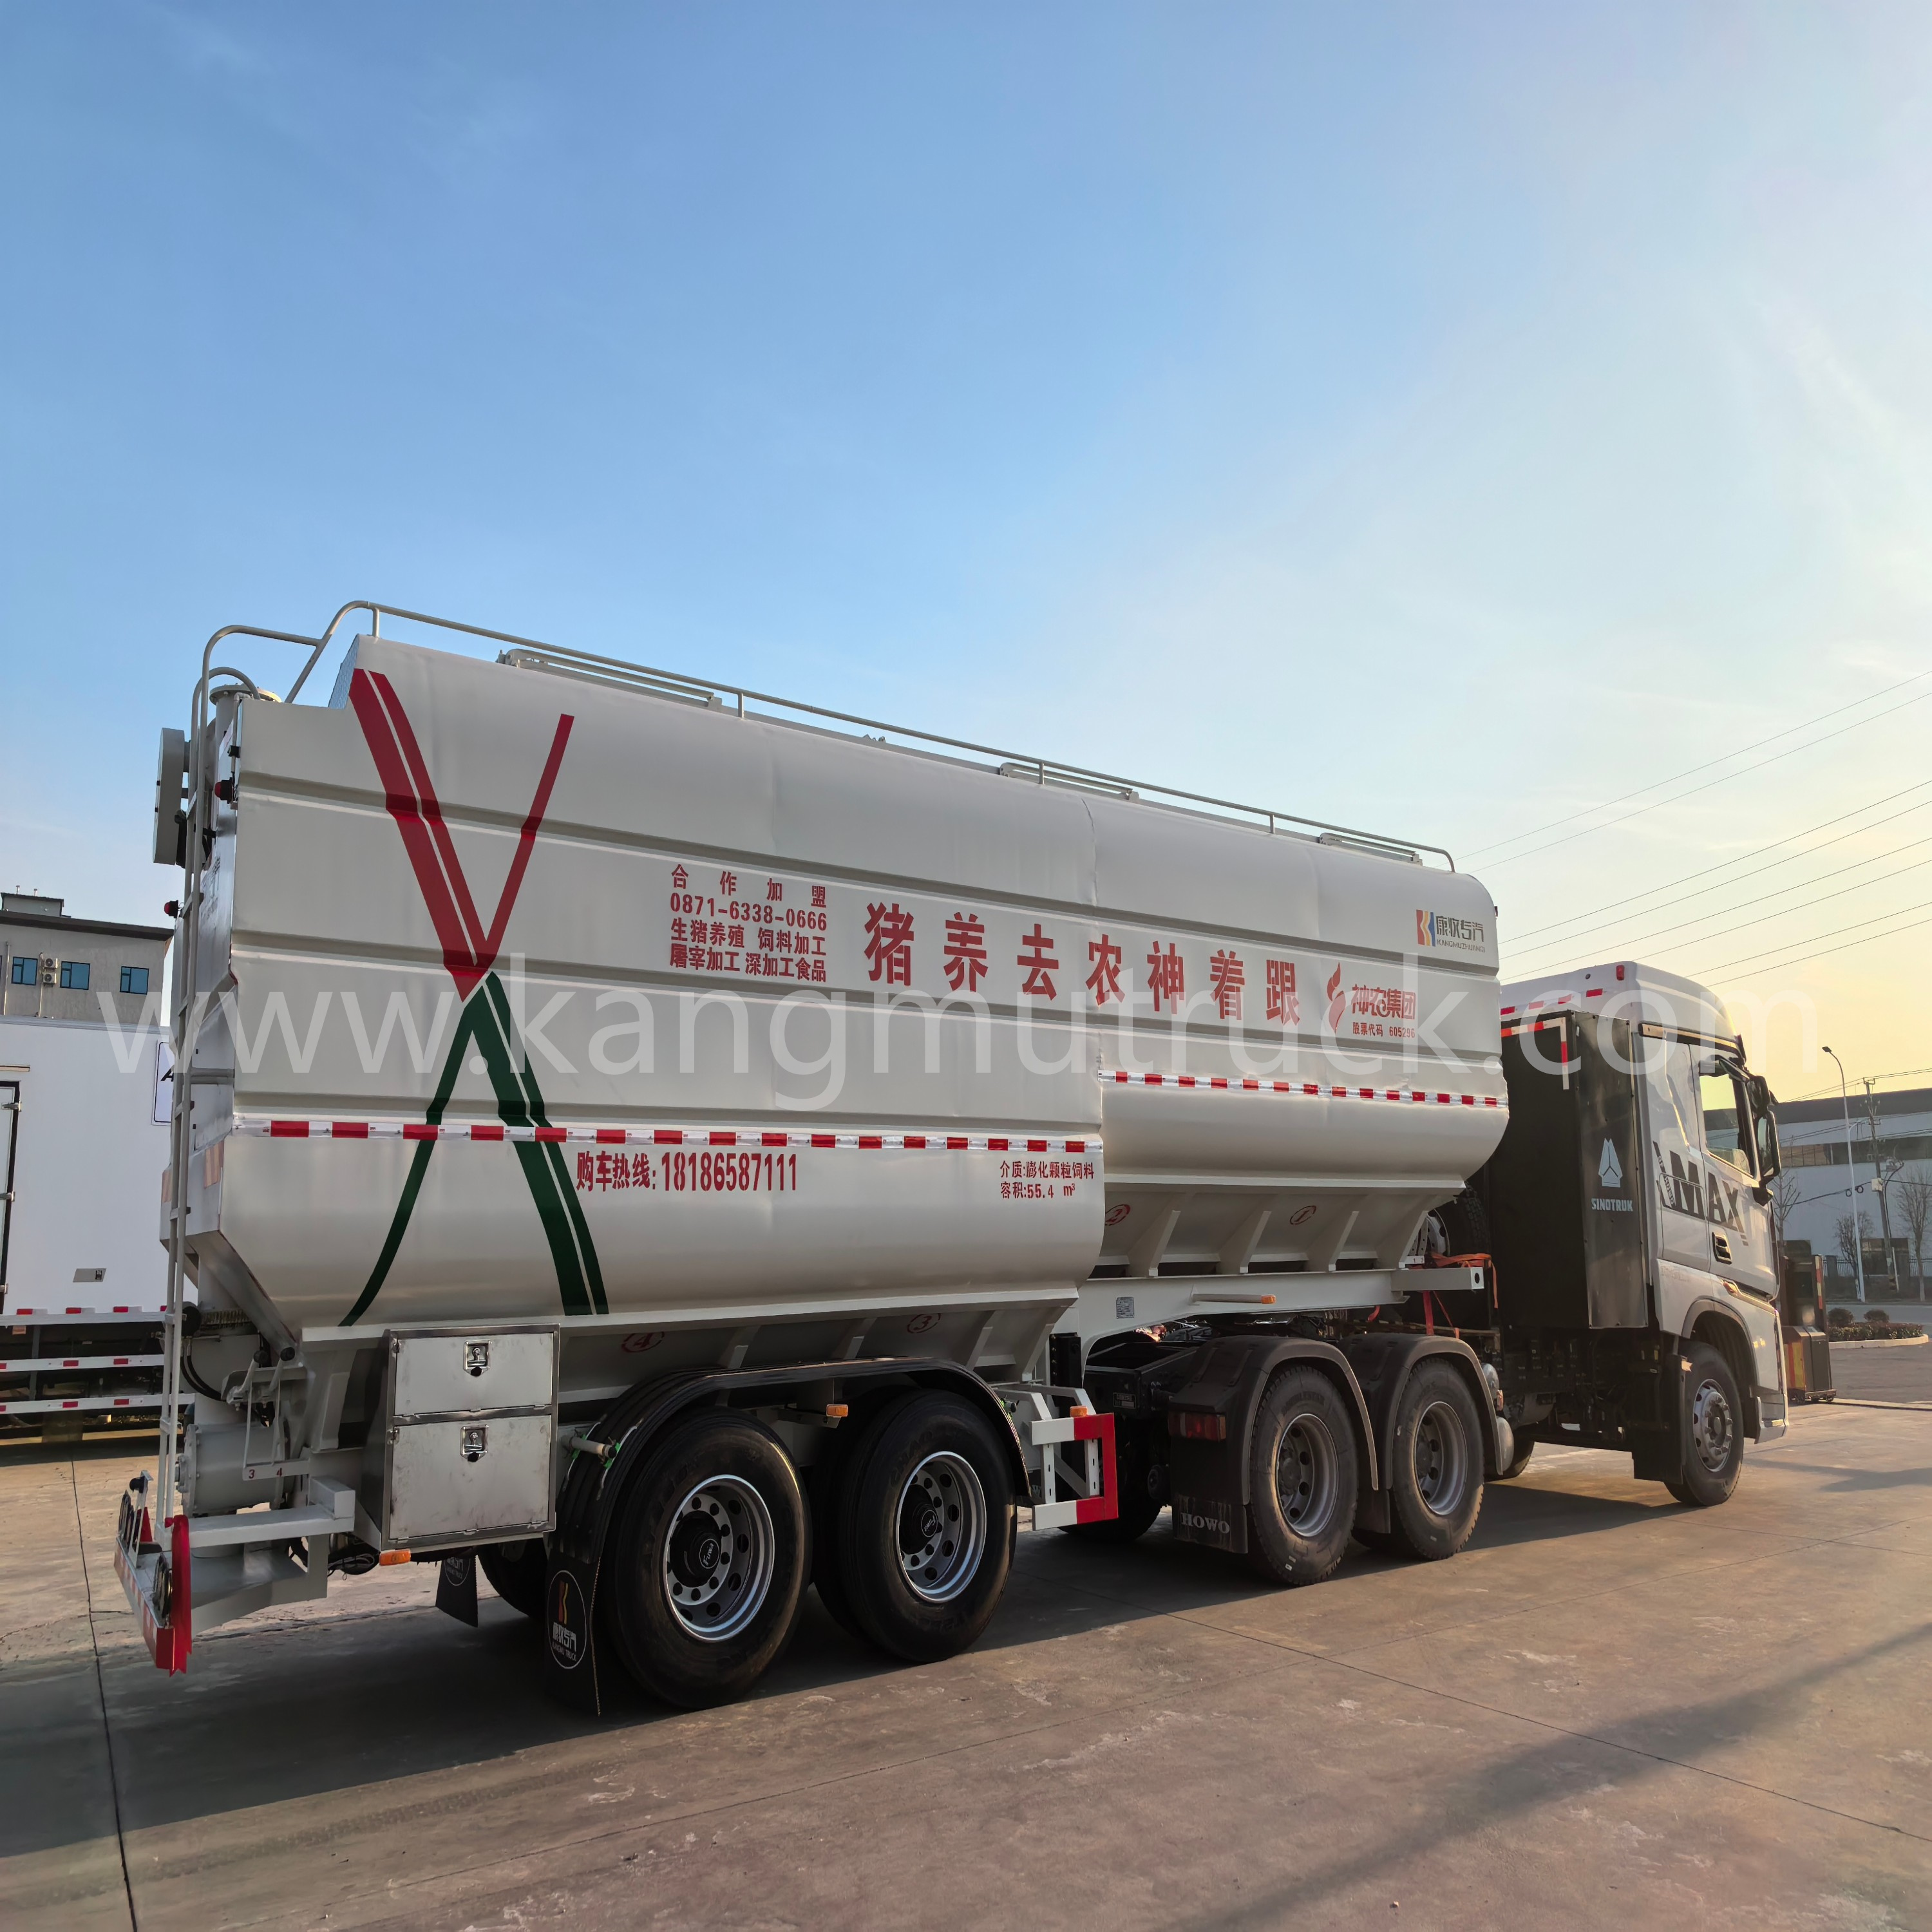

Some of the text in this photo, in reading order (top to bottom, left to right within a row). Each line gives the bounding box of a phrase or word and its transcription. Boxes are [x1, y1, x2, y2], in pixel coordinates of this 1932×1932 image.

[670, 893, 827, 931] 0871-6338-0666
[671, 917, 826, 955] 生猪养殖 饲料加工
[670, 943, 826, 982] 屠宰加工 深加工食品
[1352, 1022, 1415, 1038] 股票代码 605296
[1591, 1198, 1634, 1212] SINOTRUK
[1180, 1512, 1230, 1534] HOWO
